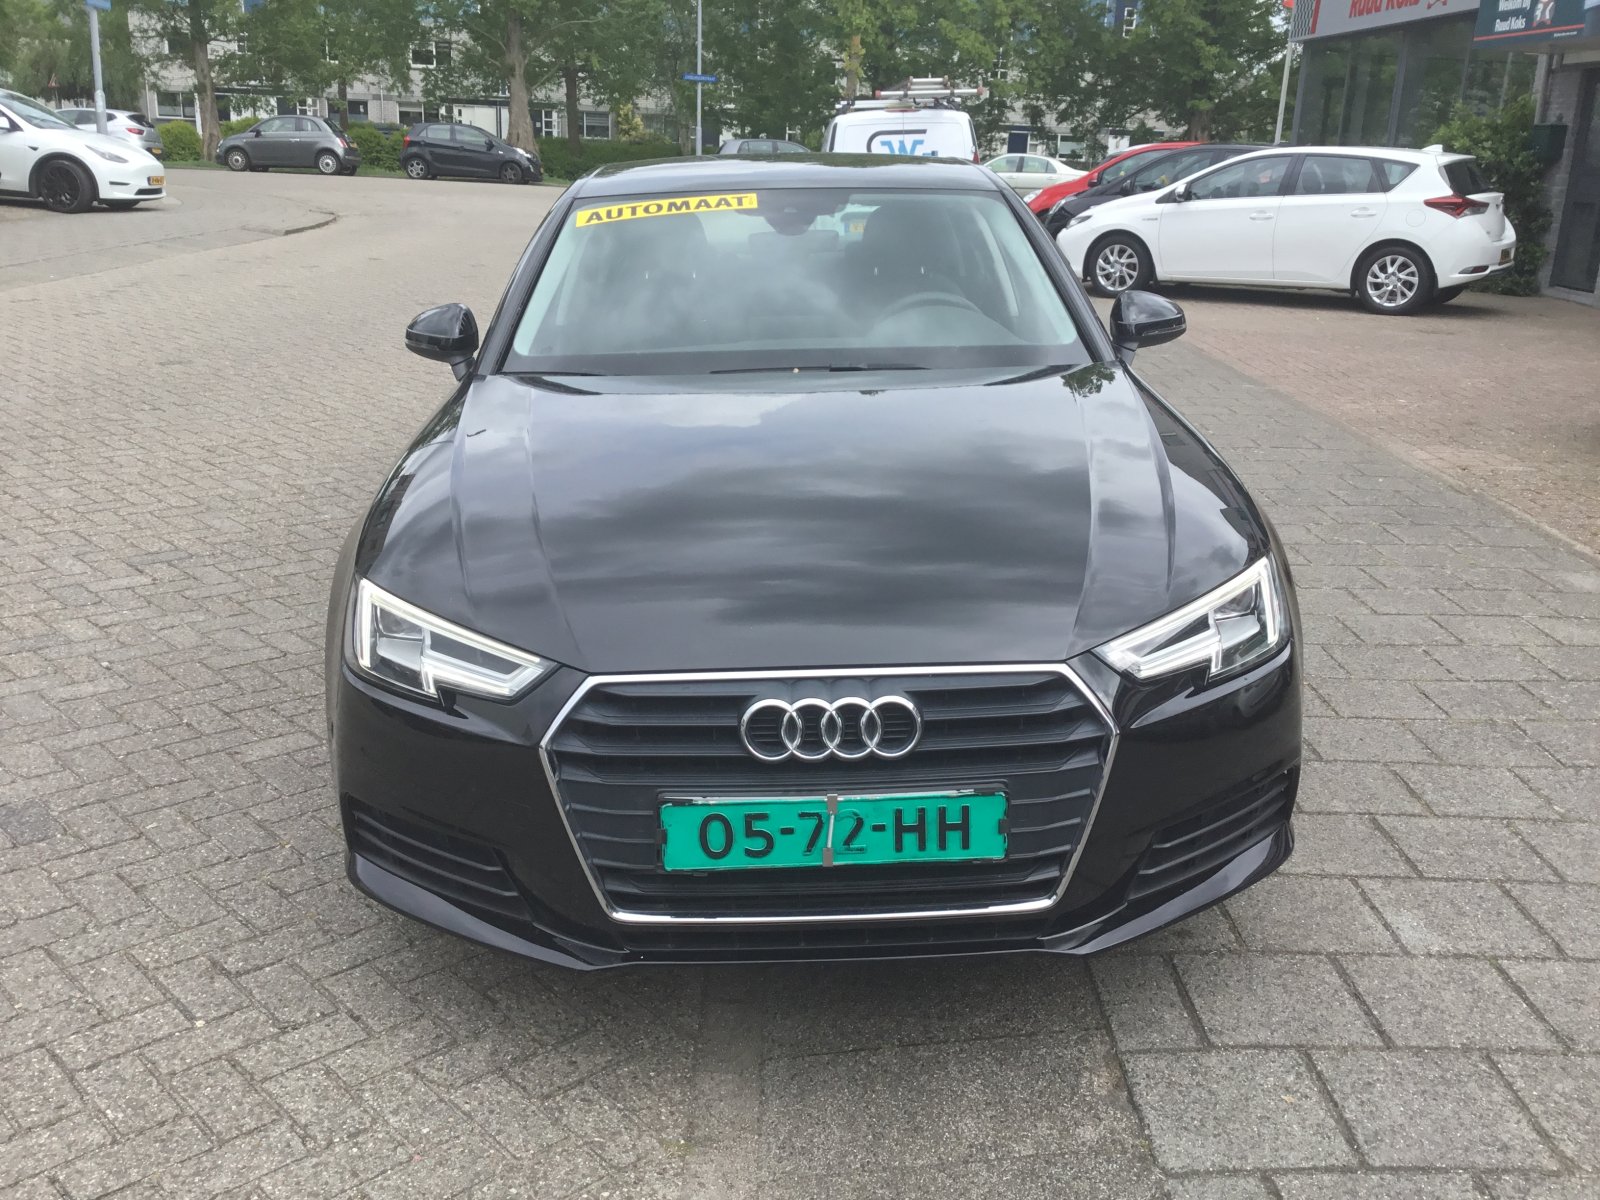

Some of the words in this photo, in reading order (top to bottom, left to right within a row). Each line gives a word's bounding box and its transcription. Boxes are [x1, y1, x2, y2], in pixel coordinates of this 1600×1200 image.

[1494, 16, 1512, 32] Ruud
[1510, 15, 1526, 29] Koks
[585, 195, 749, 224] AUTOMAAT
[699, 804, 971, 860] 05-72-HH
